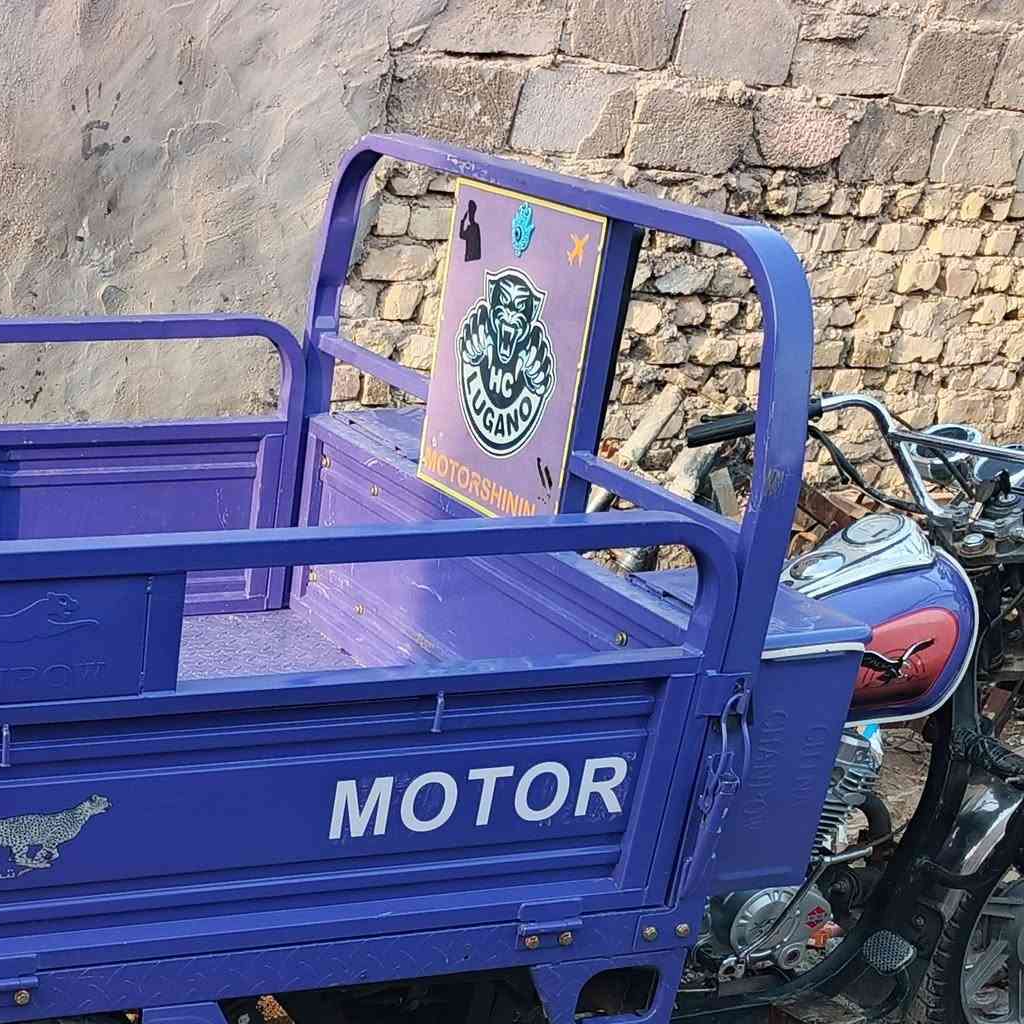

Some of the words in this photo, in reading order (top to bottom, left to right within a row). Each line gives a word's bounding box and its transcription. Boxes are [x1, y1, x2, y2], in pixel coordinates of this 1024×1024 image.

[466, 371, 533, 437] LUGANO
[489, 366, 514, 398] HC
[329, 756, 627, 840] MOTOR
